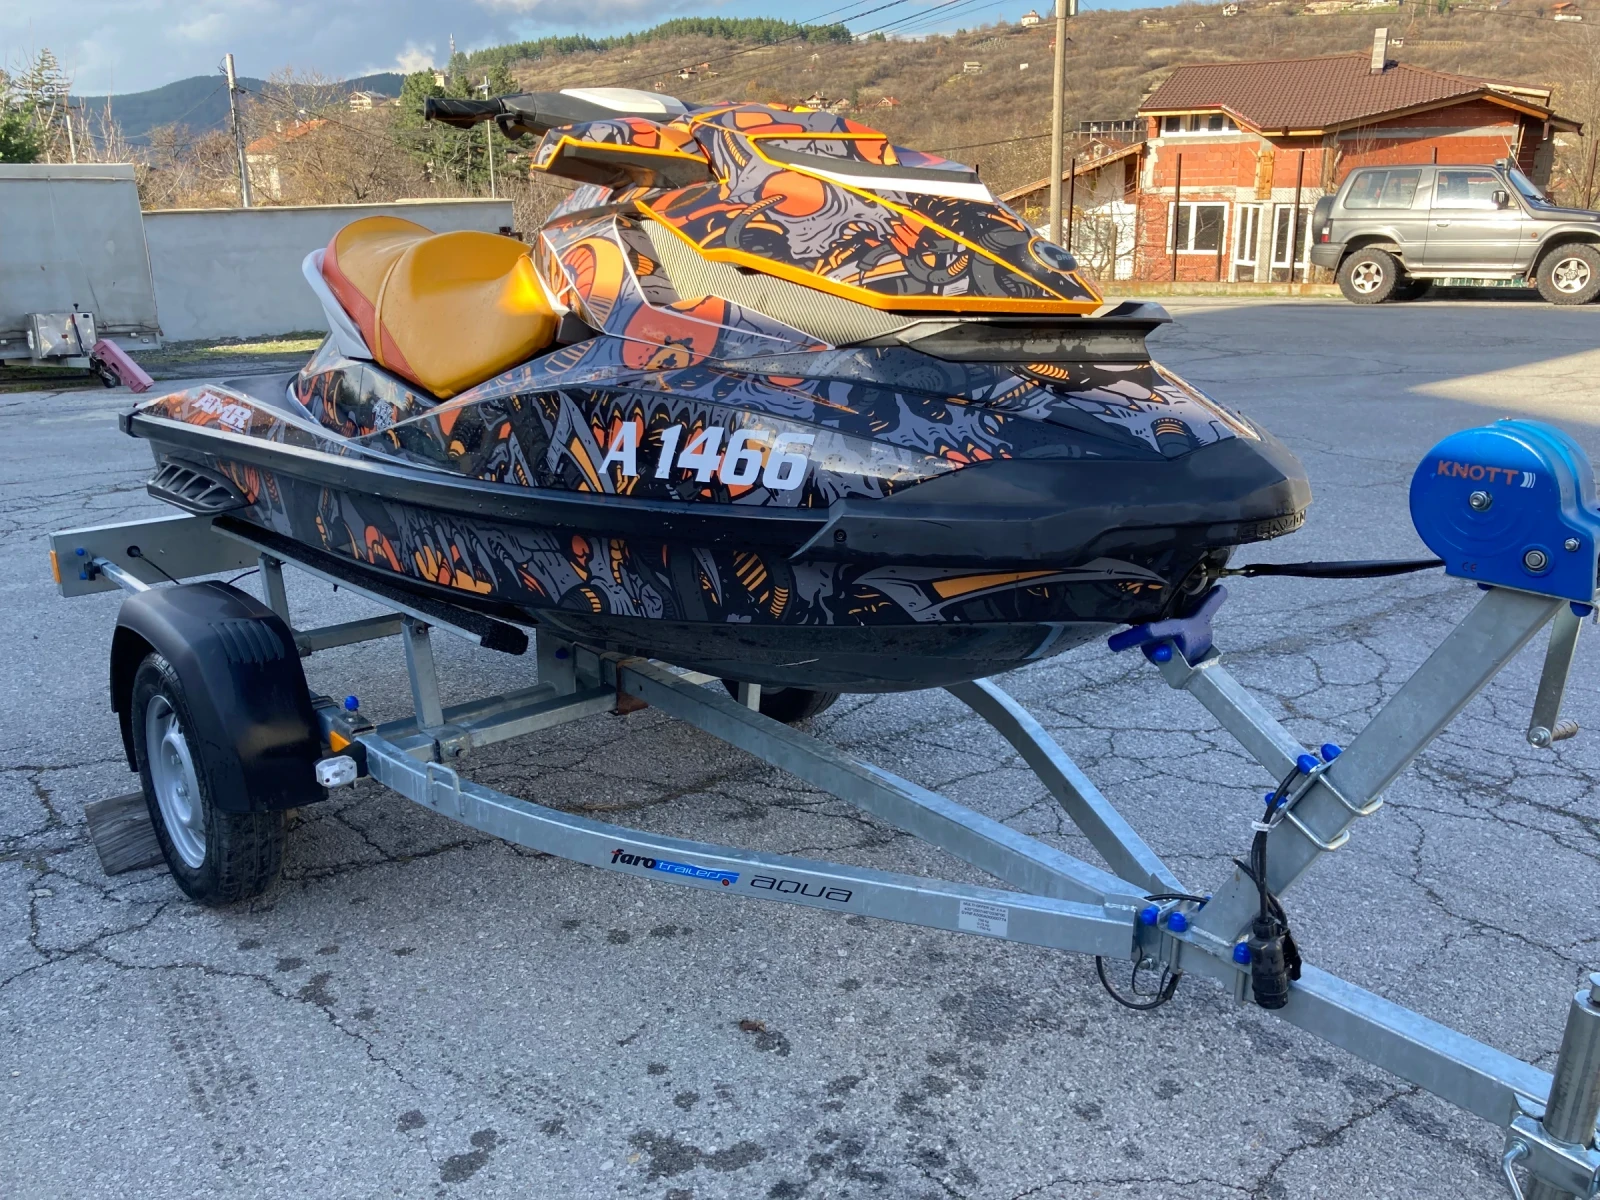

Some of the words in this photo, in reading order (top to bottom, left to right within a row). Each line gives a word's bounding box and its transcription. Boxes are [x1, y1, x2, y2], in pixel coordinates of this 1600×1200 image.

[598, 421, 637, 477] A
[654, 424, 816, 491] 1466
[1437, 460, 1519, 486] KNOTT
[610, 848, 657, 869] faro
[658, 861, 723, 880] trailers
